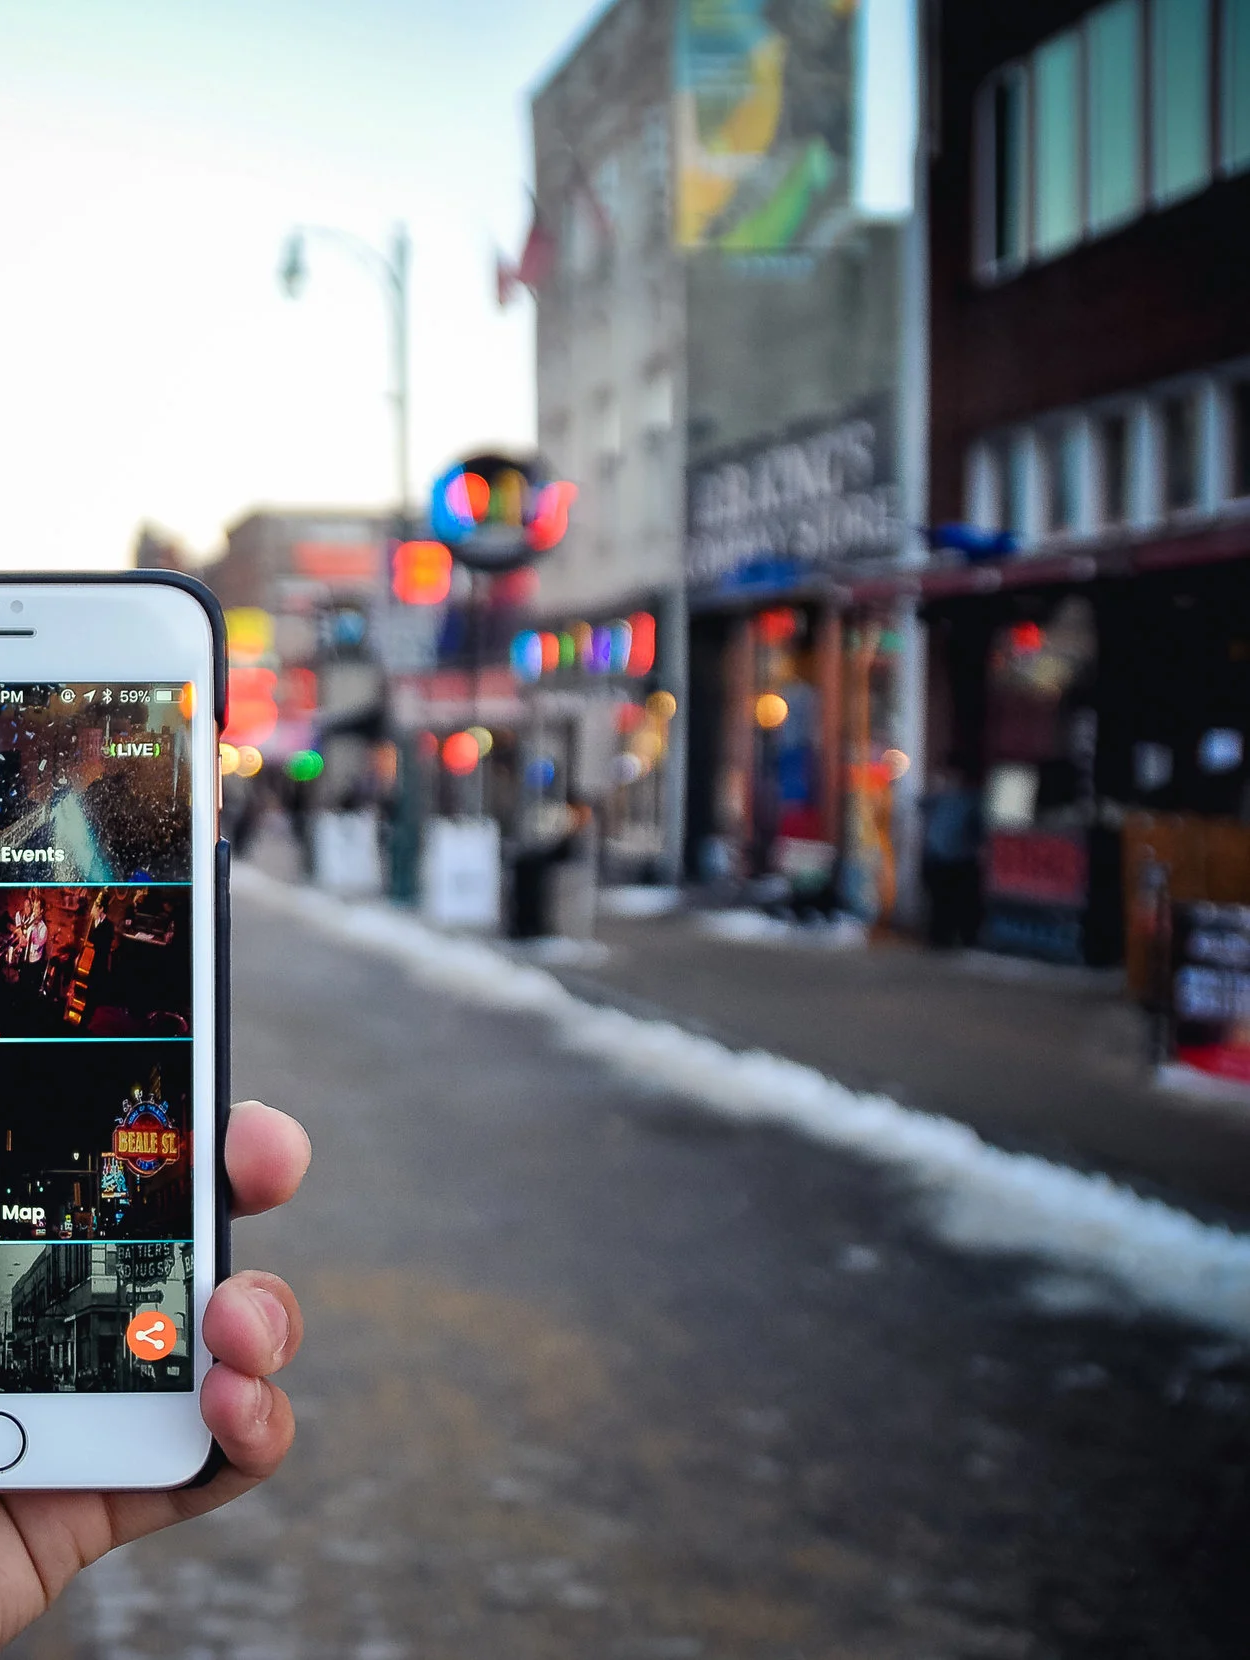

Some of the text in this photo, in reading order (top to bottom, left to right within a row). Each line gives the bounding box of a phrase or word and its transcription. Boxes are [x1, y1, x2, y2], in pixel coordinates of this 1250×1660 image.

[0, 690, 24, 703] PM
[119, 690, 150, 704] 59%
[1, 846, 65, 863] Events
[117, 1130, 158, 1154] BEALE
[2, 1204, 45, 1225] Map
